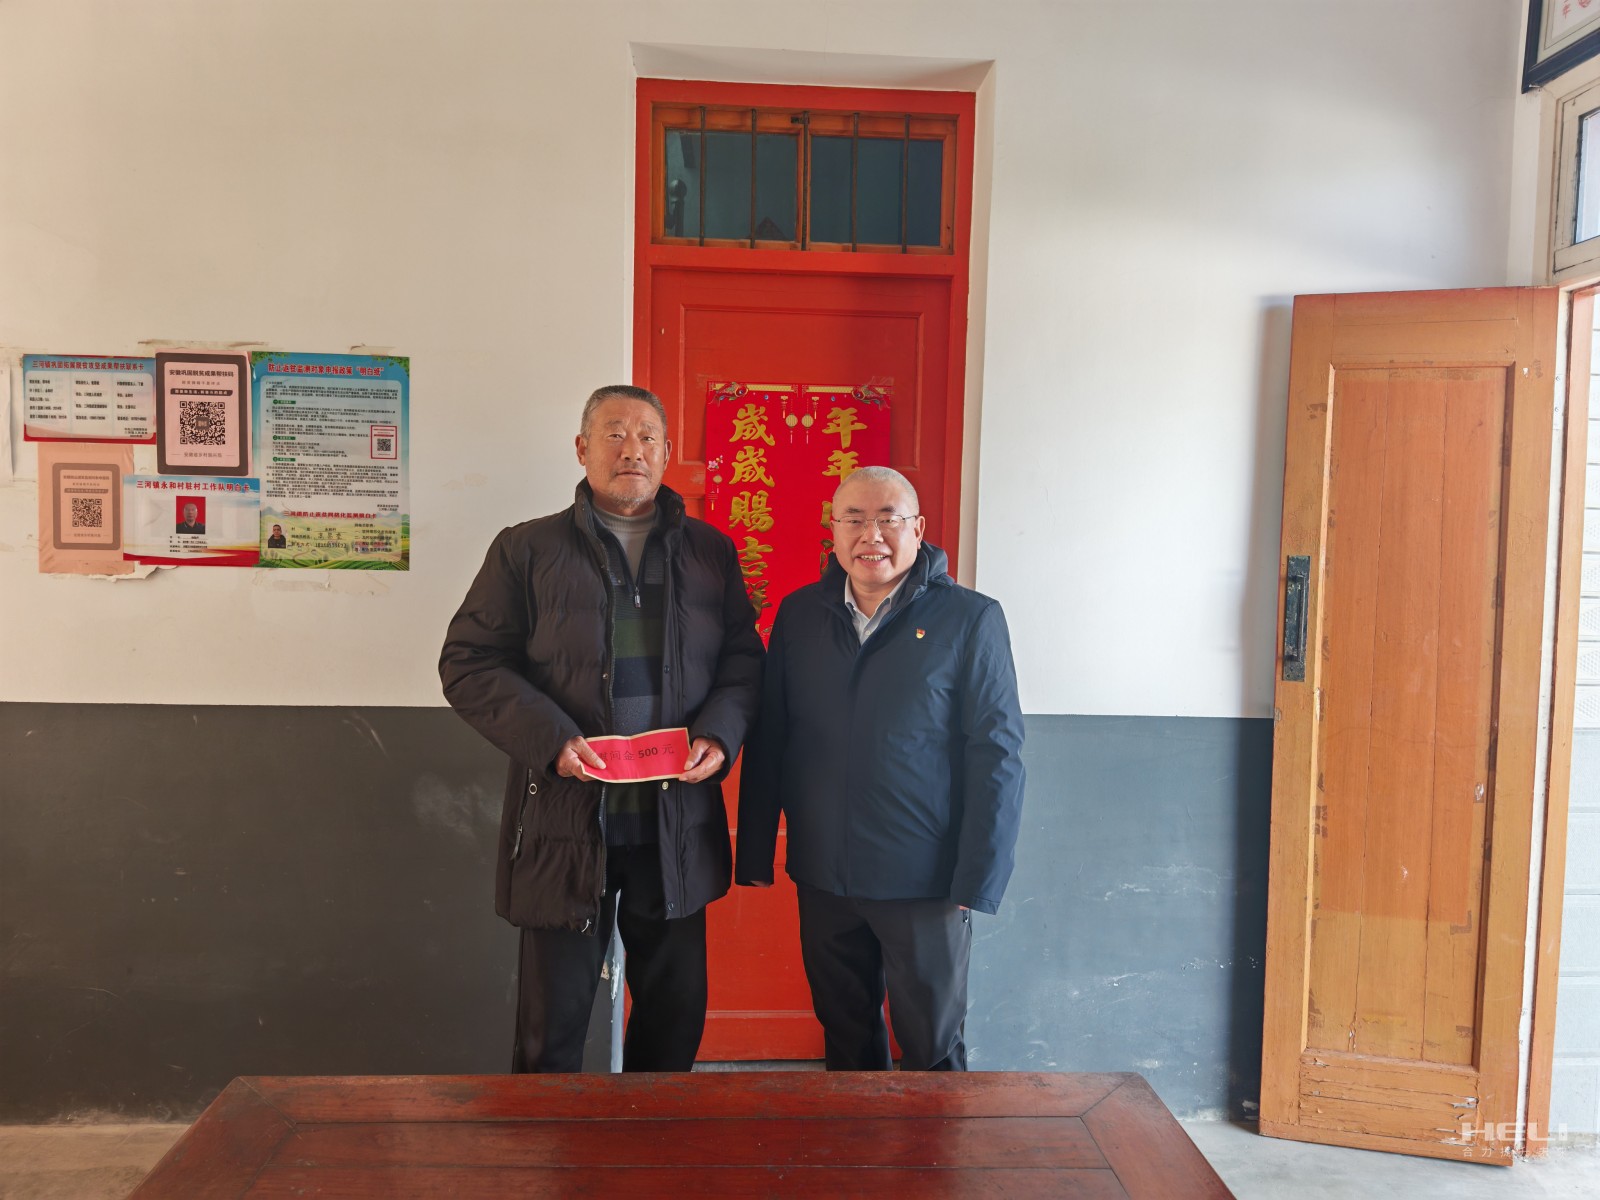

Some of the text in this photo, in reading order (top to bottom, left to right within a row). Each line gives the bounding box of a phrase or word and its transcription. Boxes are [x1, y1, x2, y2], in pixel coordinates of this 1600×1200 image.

[136, 480, 251, 494] 三河镇永和村驻村工作队明白卡
[637, 746, 659, 759] 500
[661, 743, 675, 756] 元
